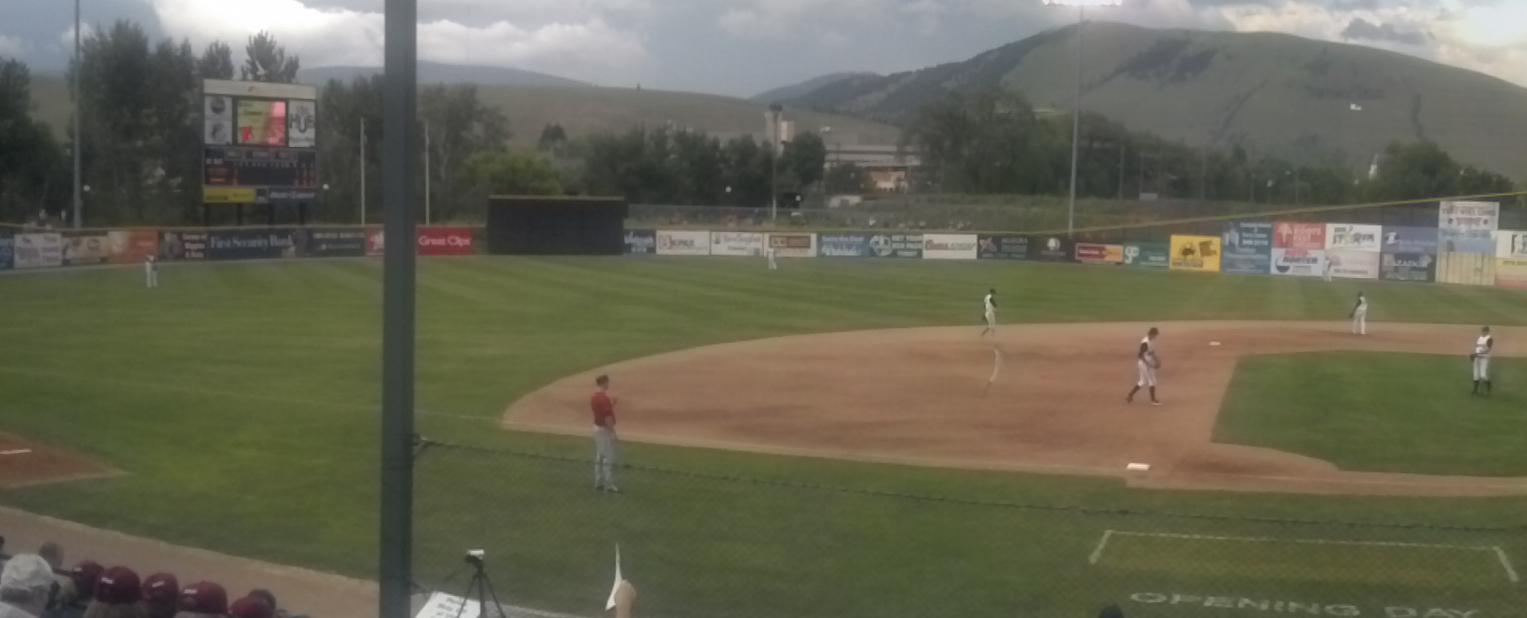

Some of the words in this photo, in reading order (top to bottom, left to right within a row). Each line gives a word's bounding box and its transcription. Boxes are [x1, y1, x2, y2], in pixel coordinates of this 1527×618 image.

[210, 236, 231, 248] First
[232, 236, 268, 251] Security
[269, 234, 293, 246] Bank
[418, 235, 445, 246] Great
[448, 235, 473, 248] Clips
[1131, 592, 1360, 616] OPENING
[1384, 605, 1480, 618] DAY
